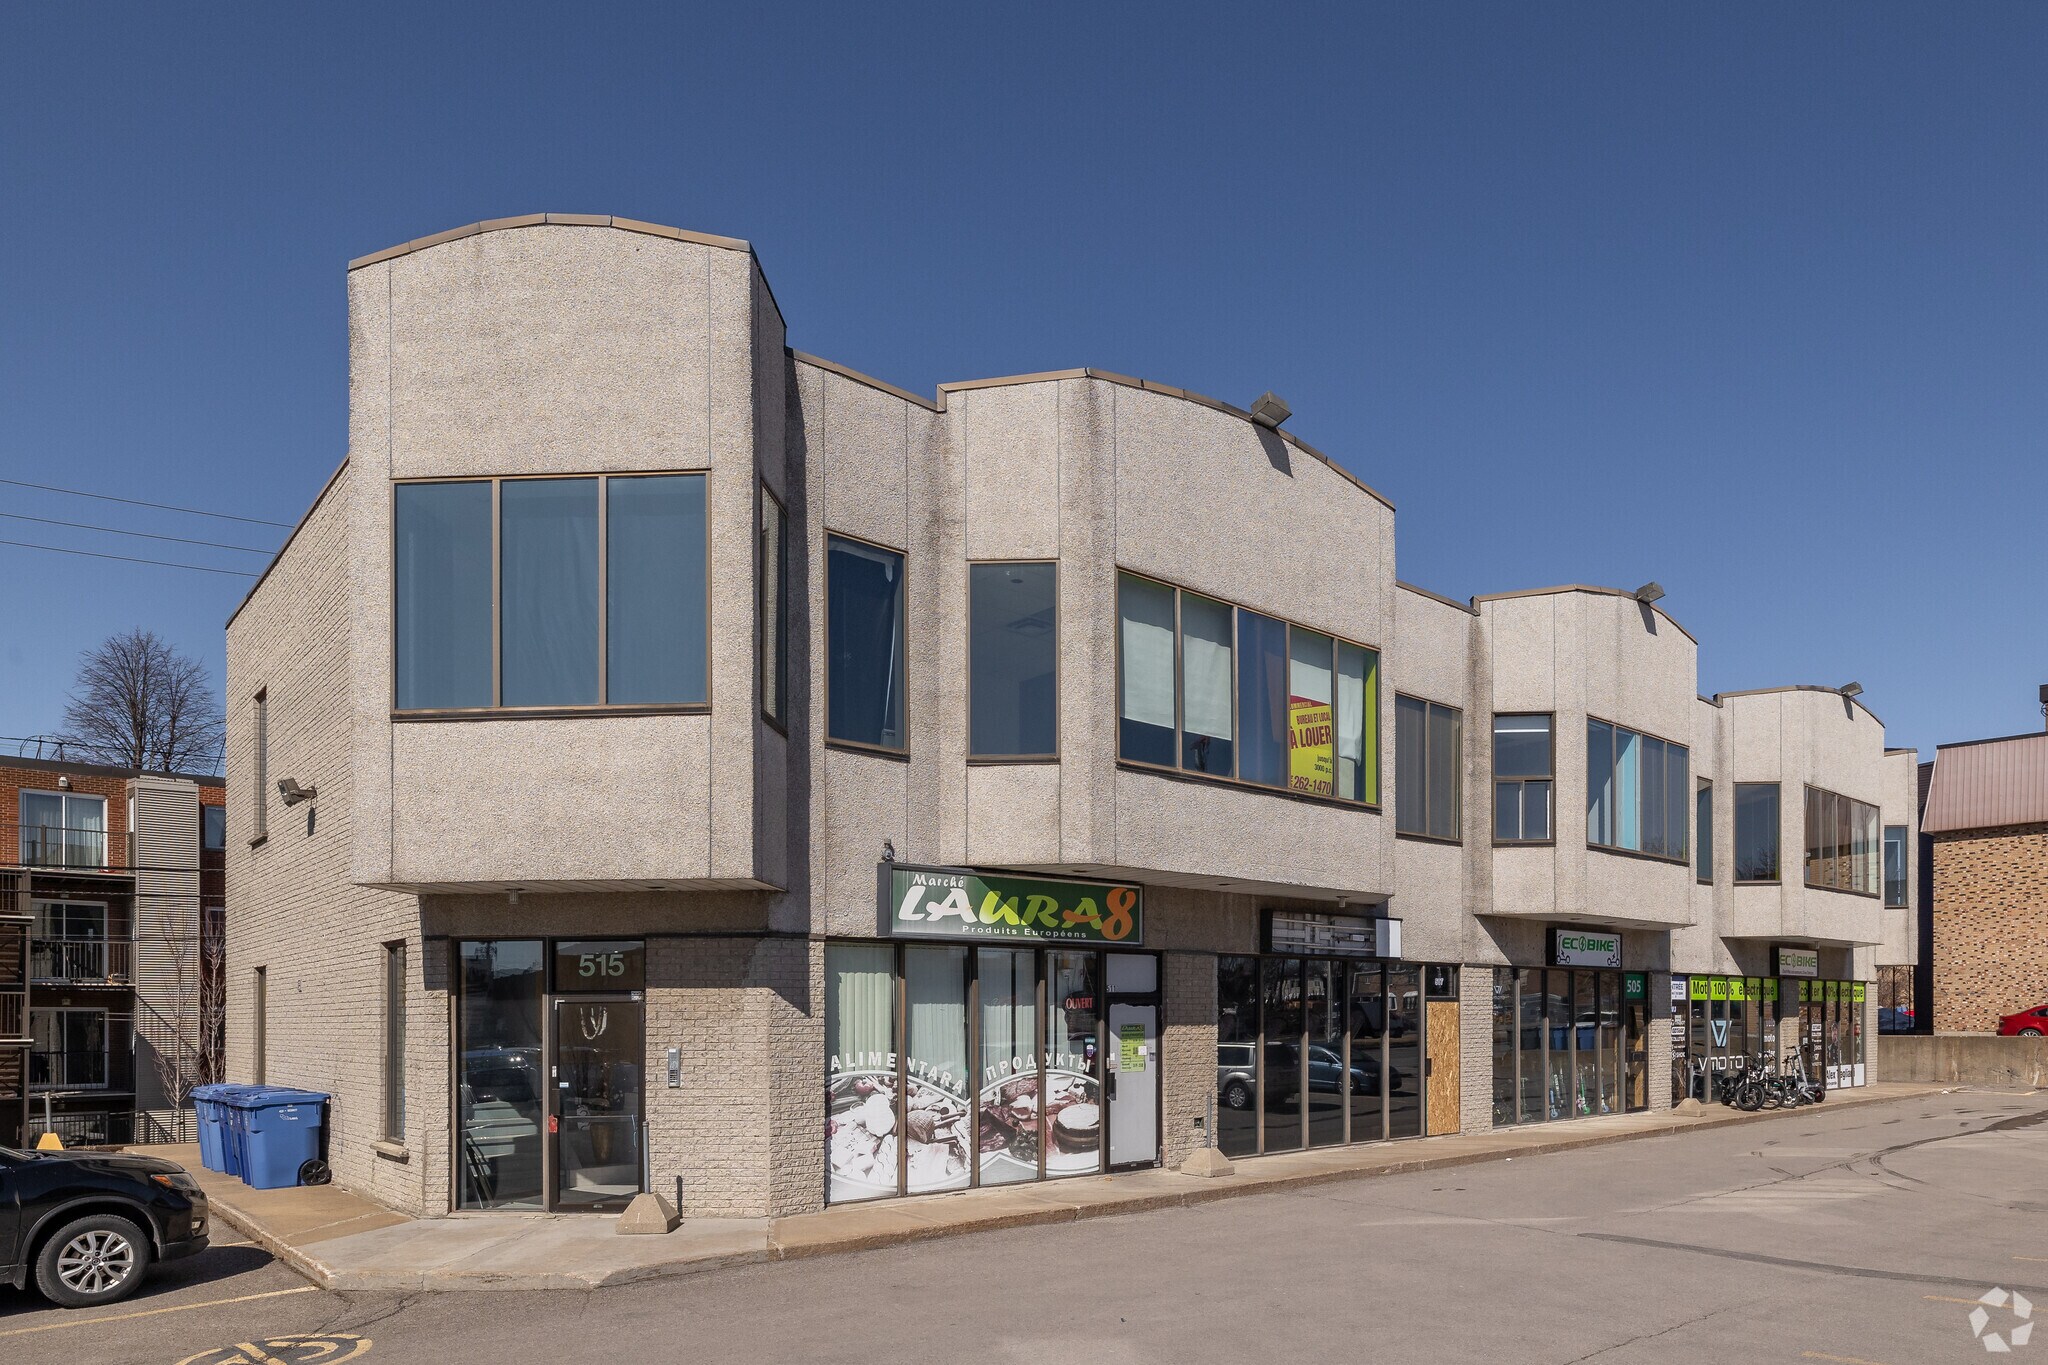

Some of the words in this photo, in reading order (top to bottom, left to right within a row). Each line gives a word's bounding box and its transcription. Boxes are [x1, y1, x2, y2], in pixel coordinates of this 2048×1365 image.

[1313, 713, 1318, 723] ET
[1290, 726, 1298, 749] À
[1299, 725, 1332, 748] LOUER
[1293, 775, 1331, 795] 262-1470
[912, 873, 964, 888] Marché
[962, 925, 1018, 936] Produits
[1024, 927, 1087, 939] Européens
[1562, 935, 1615, 952] ECOBIKE
[578, 954, 625, 977] 515
[1780, 953, 1817, 968] ECOBIKE
[1626, 980, 1641, 993] 505
[1692, 981, 1711, 995] Mot
[1066, 997, 1093, 1010] OUVERT
[830, 1051, 965, 1095] ALIMENTARA
[985, 1052, 1091, 1081] ПРОДУКТЫ
